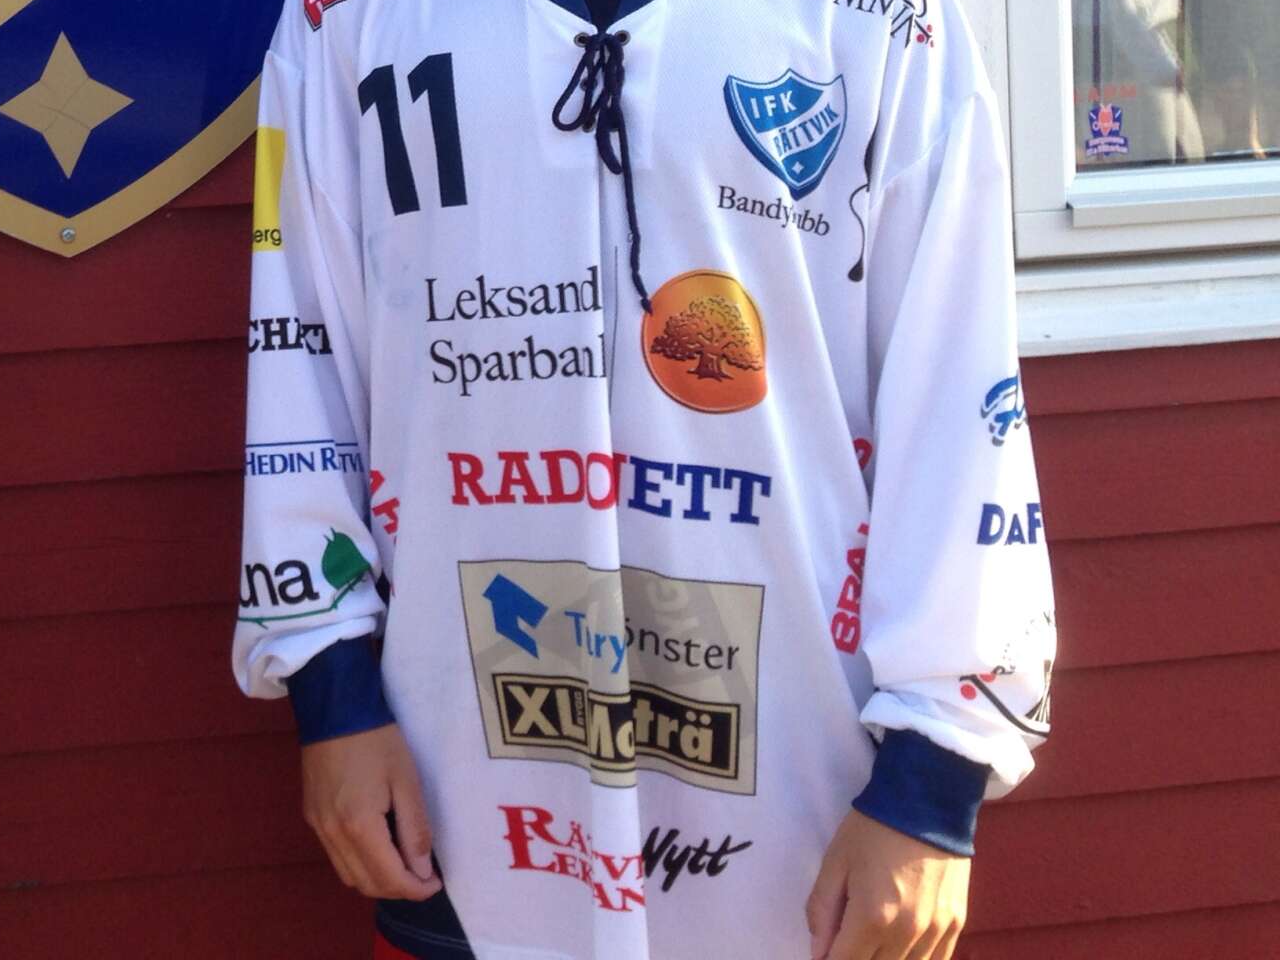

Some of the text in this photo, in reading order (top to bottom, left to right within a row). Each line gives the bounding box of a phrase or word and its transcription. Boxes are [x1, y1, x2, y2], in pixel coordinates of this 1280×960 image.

[357, 52, 468, 216] 11
[750, 90, 797, 119] IFK
[642, 826, 753, 892] Nytt
